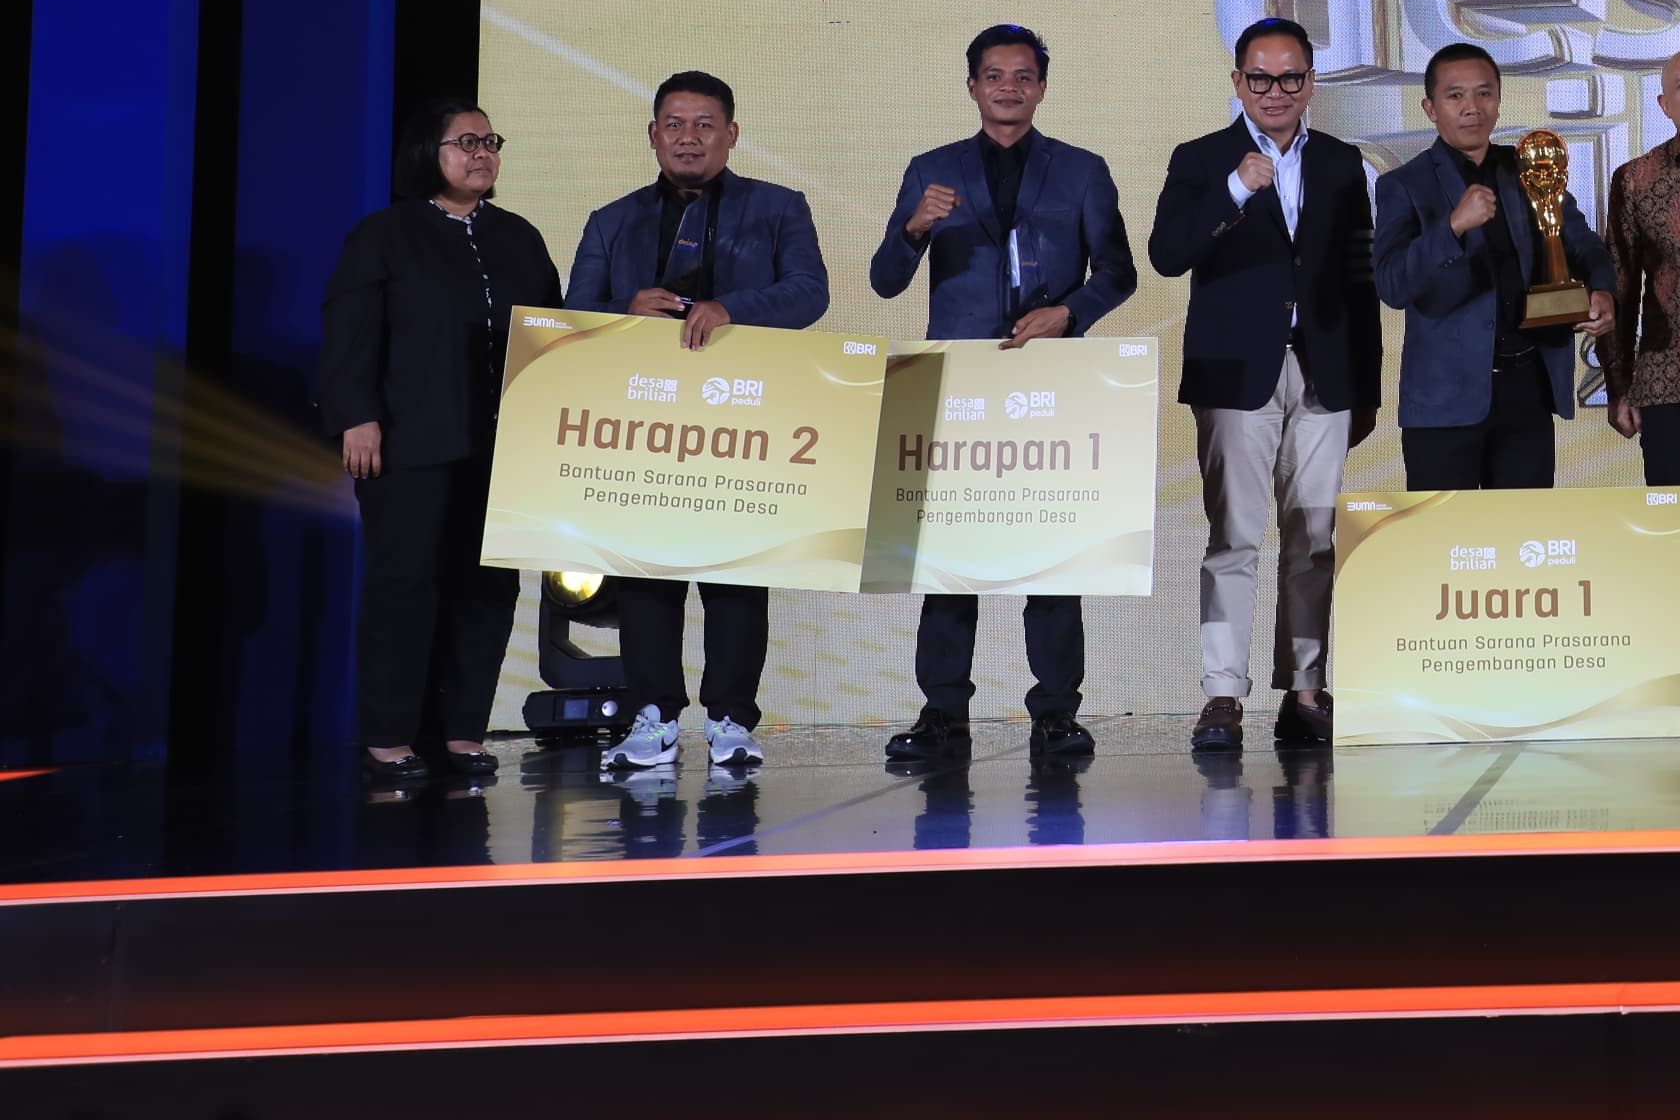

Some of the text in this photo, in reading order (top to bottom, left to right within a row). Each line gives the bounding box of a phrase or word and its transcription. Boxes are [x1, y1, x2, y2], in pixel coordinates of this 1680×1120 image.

[856, 342, 877, 356] BRI
[1130, 344, 1148, 356] BRI
[628, 373, 664, 388] desa
[732, 378, 764, 397] BRI
[627, 386, 678, 403] brilian
[731, 396, 761, 407] peduli
[945, 396, 974, 409] desa
[1030, 391, 1056, 408] BRI
[944, 408, 985, 421] brilian
[1030, 407, 1055, 418] peduli
[556, 407, 820, 465] Harapan 2
[897, 432, 1100, 479] Harapan 1
[559, 463, 808, 496] Bantuan Sarana Prasarana
[583, 487, 780, 516] Pengembangan Desa
[896, 487, 1101, 502] Bantuan Sarana Prasarana
[1658, 492, 1678, 504] BRI
[917, 509, 1077, 525] Pengembangan Desa
[1450, 544, 1483, 560] desa
[1547, 539, 1576, 557] BRI
[1450, 556, 1496, 571] brilian
[1547, 555, 1576, 567] peduli
[1435, 580, 1592, 622] Juara 1
[1396, 633, 1631, 653] Bantuan Sarana Prasarana
[1422, 655, 1606, 675] Pengembangan Desa
